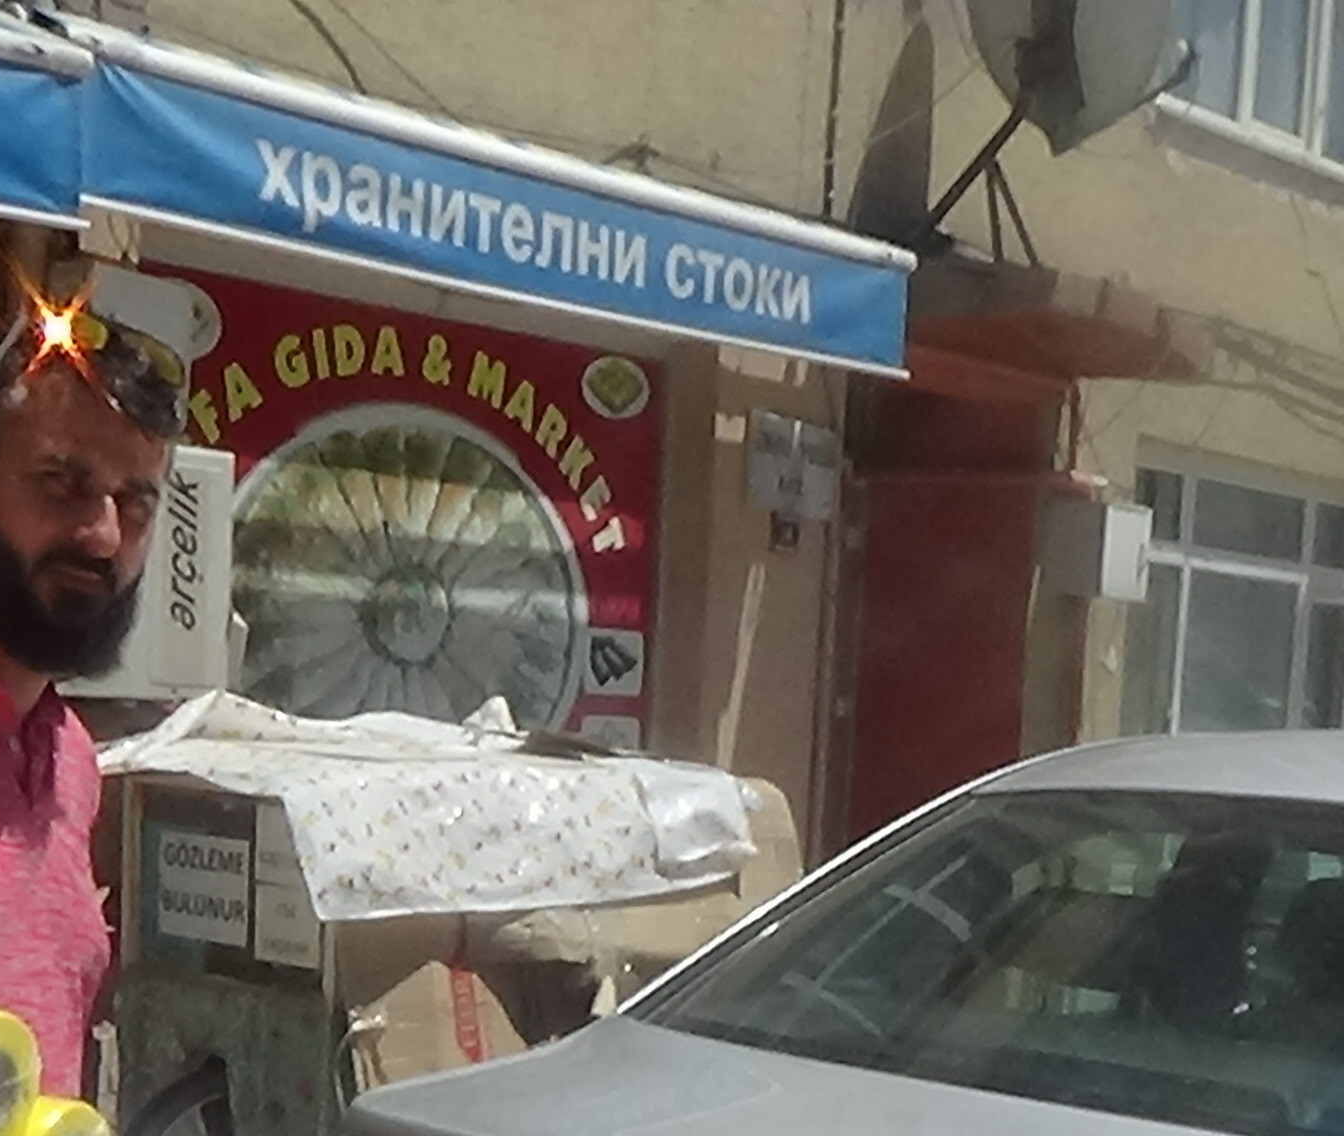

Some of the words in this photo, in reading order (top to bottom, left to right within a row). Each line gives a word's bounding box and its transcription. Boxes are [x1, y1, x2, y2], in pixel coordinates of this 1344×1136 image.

[256, 138, 646, 289] хранителни
[664, 241, 812, 325] стоки
[187, 361, 263, 444] FA
[273, 323, 405, 389] GIDA
[421, 334, 451, 385] &
[466, 350, 627, 557] MARKET
[167, 470, 205, 631] arçelik
